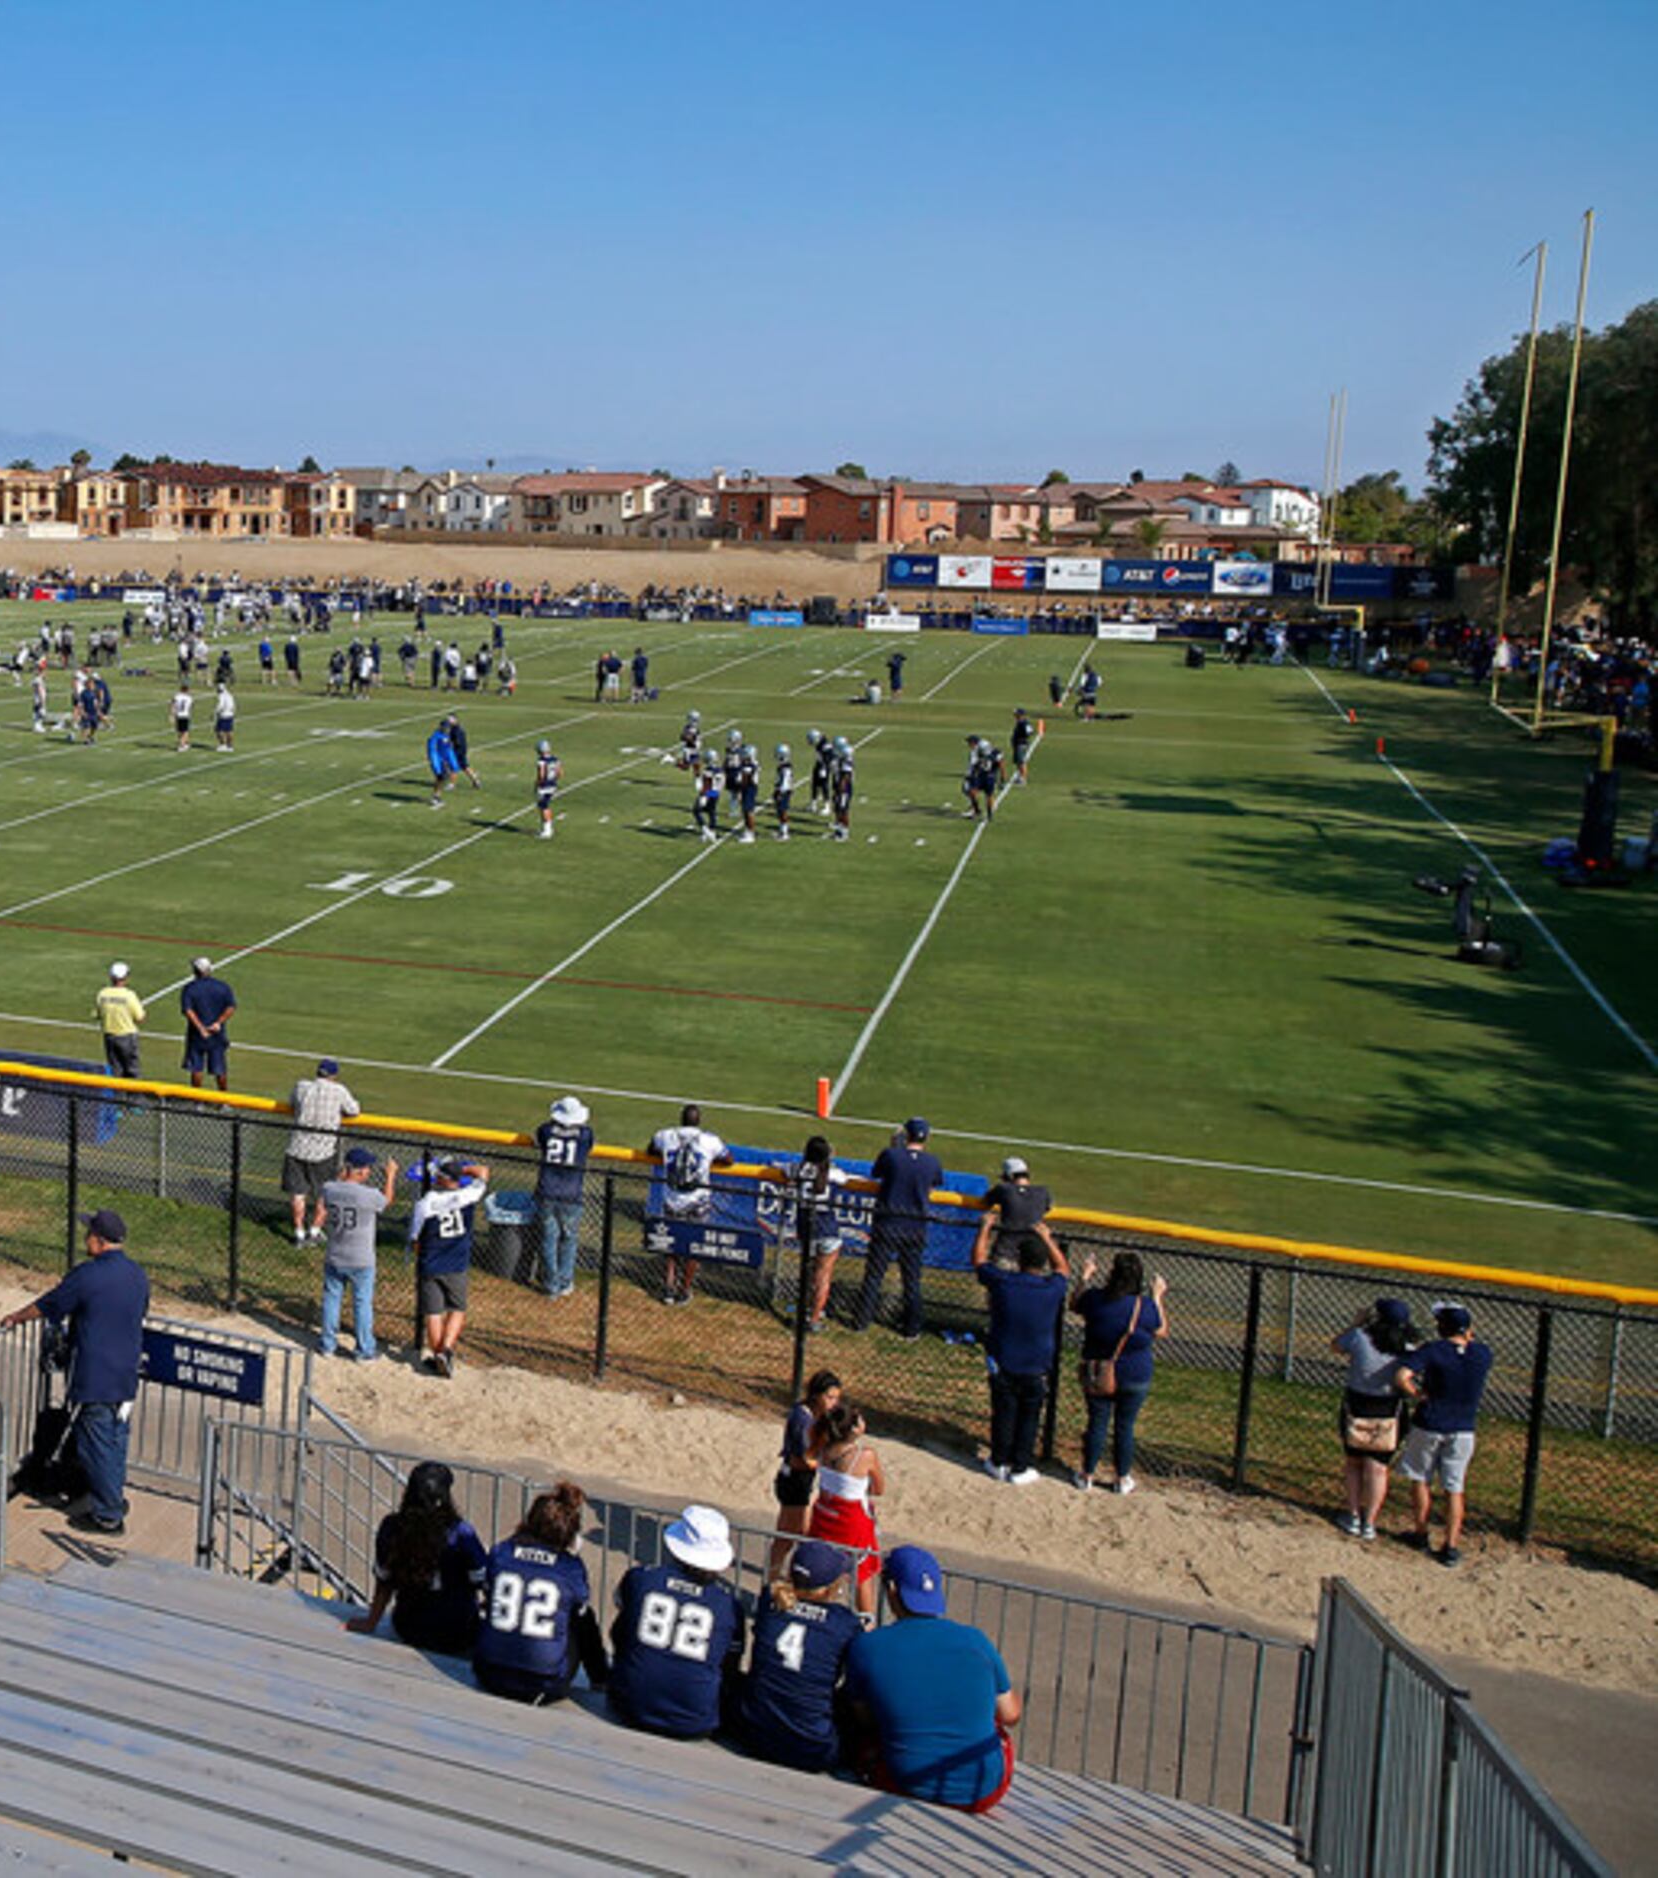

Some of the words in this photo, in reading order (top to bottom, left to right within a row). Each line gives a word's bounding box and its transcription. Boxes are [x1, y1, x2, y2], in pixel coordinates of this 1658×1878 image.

[1123, 568, 1155, 581] AT&T
[304, 871, 455, 898] 10
[546, 1137, 578, 1167] 21
[439, 1208, 466, 1238] 21
[174, 1343, 191, 1362] NO
[193, 1348, 244, 1375] SMOKING
[177, 1363, 193, 1381] OR
[196, 1368, 238, 1394] VAPING
[491, 1571, 561, 1639] 82
[637, 1591, 714, 1663] 82
[776, 1621, 807, 1672] 4
